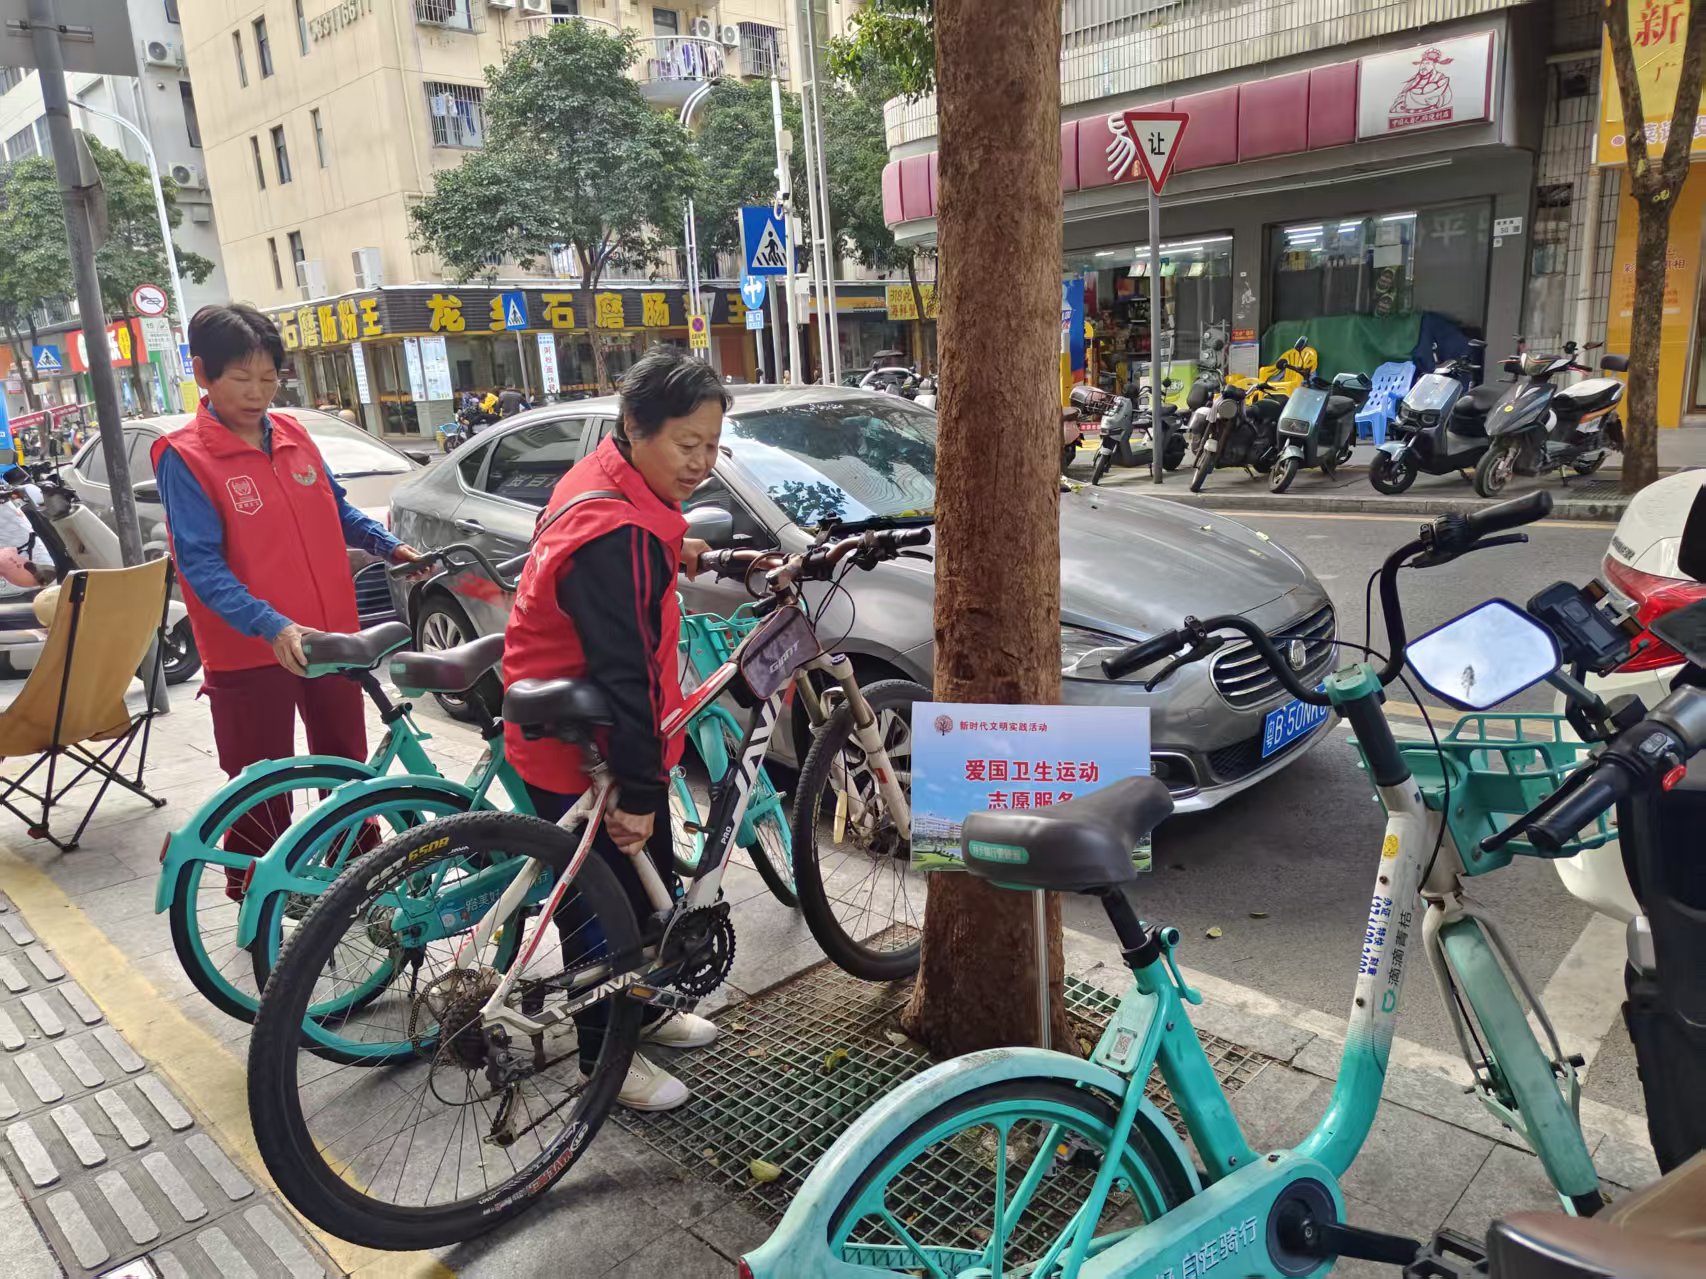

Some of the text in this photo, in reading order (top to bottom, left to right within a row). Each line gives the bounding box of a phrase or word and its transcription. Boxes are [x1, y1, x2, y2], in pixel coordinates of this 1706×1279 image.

[1148, 132, 1165, 155] 让
[960, 720, 1048, 733] 新时代文明实践活动
[965, 759, 1099, 783] 爱国卫生运动
[720, 825, 732, 845] PRO
[1388, 911, 1412, 986] 滴滴青桔
